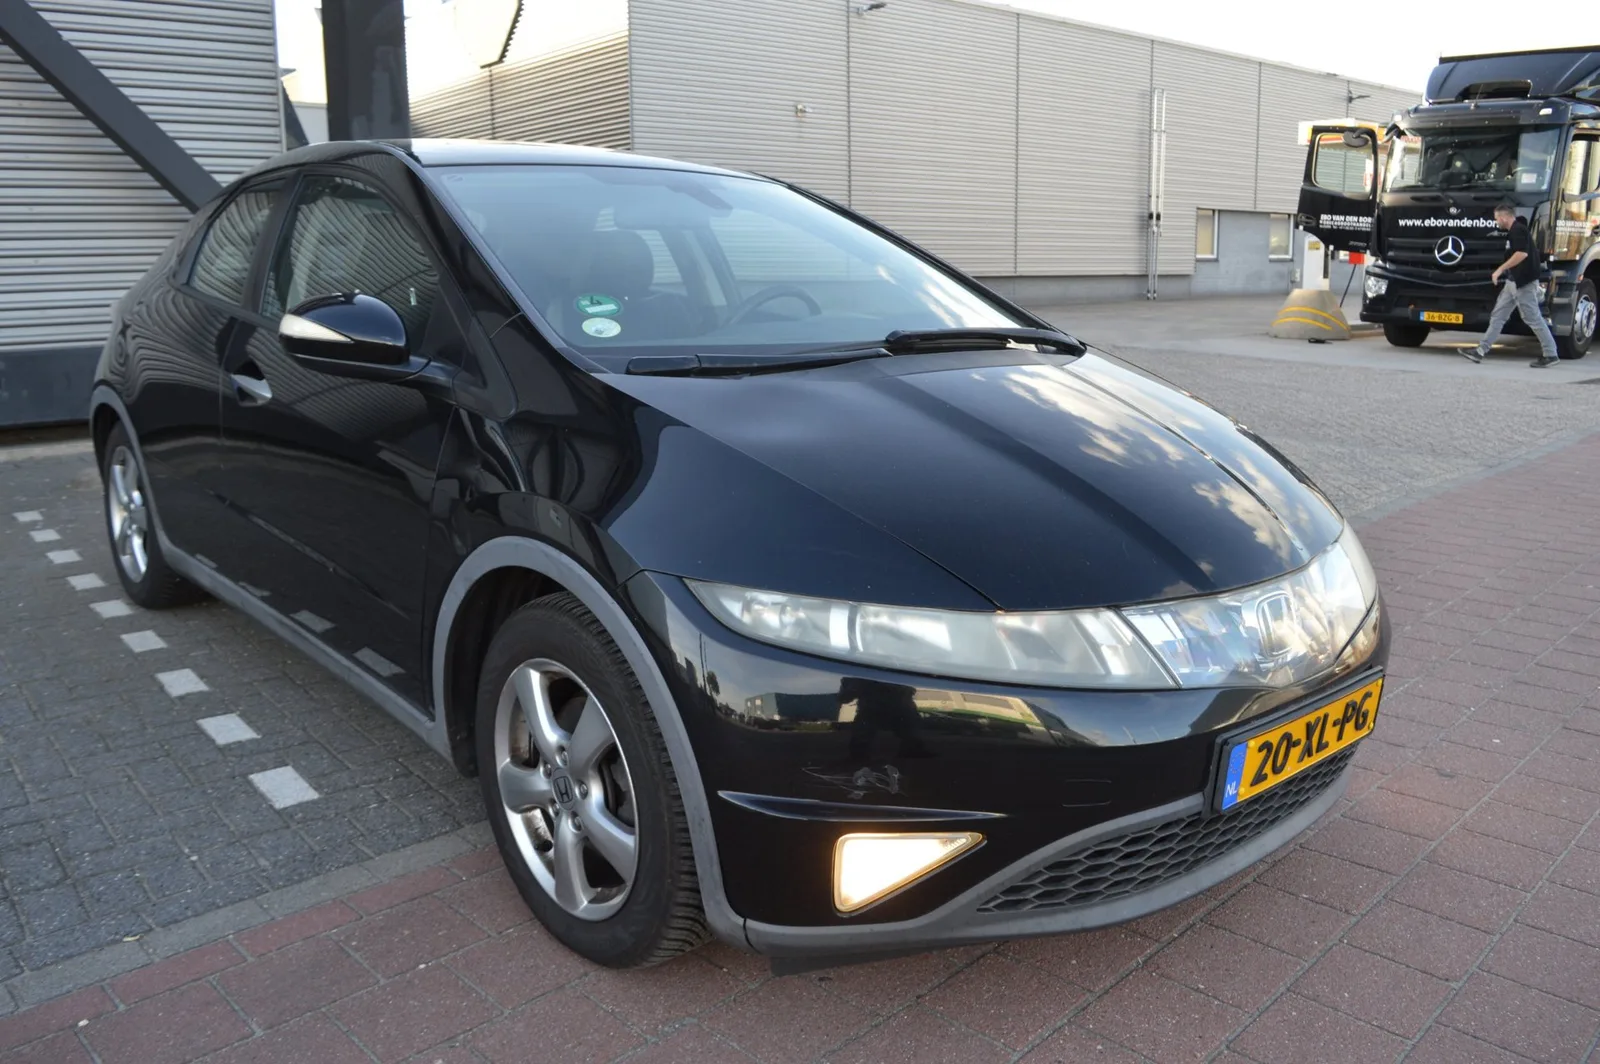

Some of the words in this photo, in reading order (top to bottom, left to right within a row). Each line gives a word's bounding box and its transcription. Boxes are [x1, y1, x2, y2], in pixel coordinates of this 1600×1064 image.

[1398, 216, 1500, 228] www.ebovandenbor.
[1426, 312, 1461, 322] 36-BZG-8
[1250, 691, 1373, 787] 20-XL-PG
[1225, 781, 1237, 797] NL
